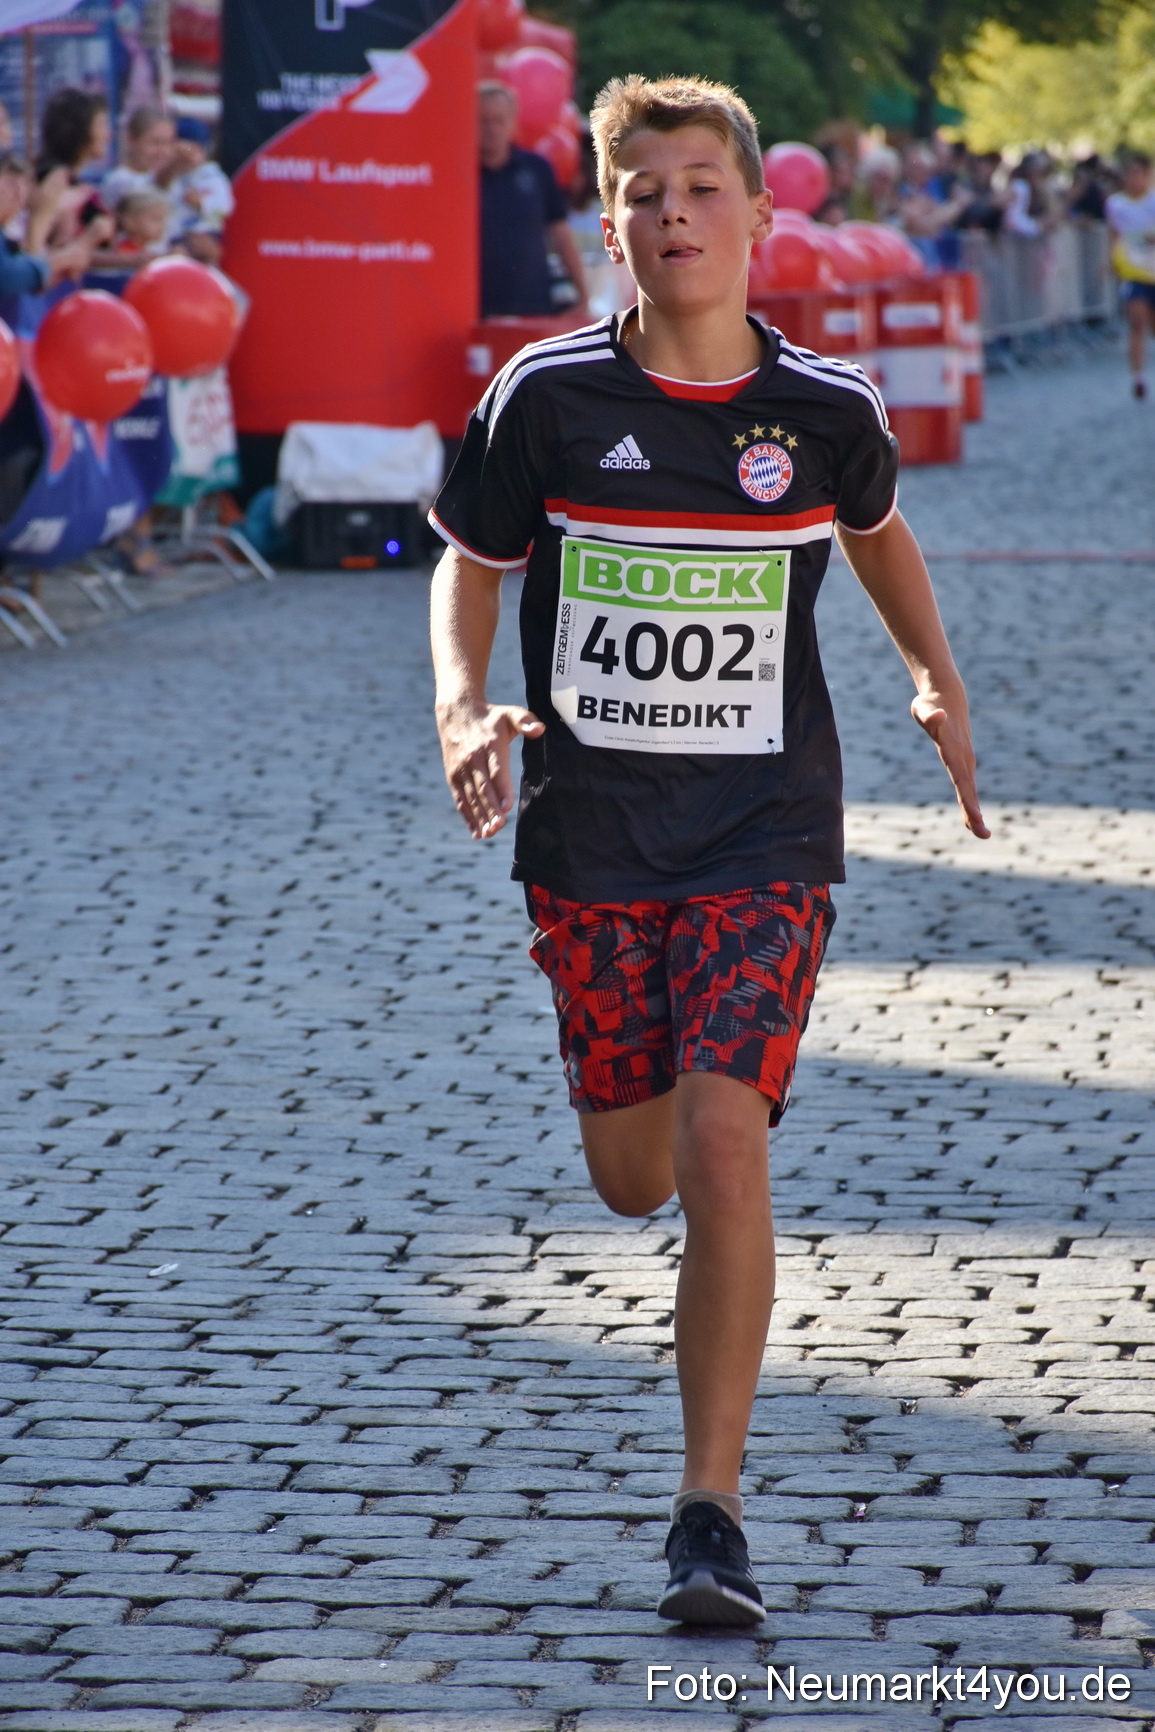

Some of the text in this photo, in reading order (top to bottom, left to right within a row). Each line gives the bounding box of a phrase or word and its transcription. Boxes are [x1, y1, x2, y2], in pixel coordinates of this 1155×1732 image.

[257, 157, 431, 186] BMW Laufsport
[600, 457, 651, 470] adidas
[741, 445, 791, 472] FC BAYERN
[579, 550, 766, 603] BOCK
[765, 628, 774, 639] J
[579, 615, 755, 682] 4002
[577, 694, 752, 728] BENEDIKT
